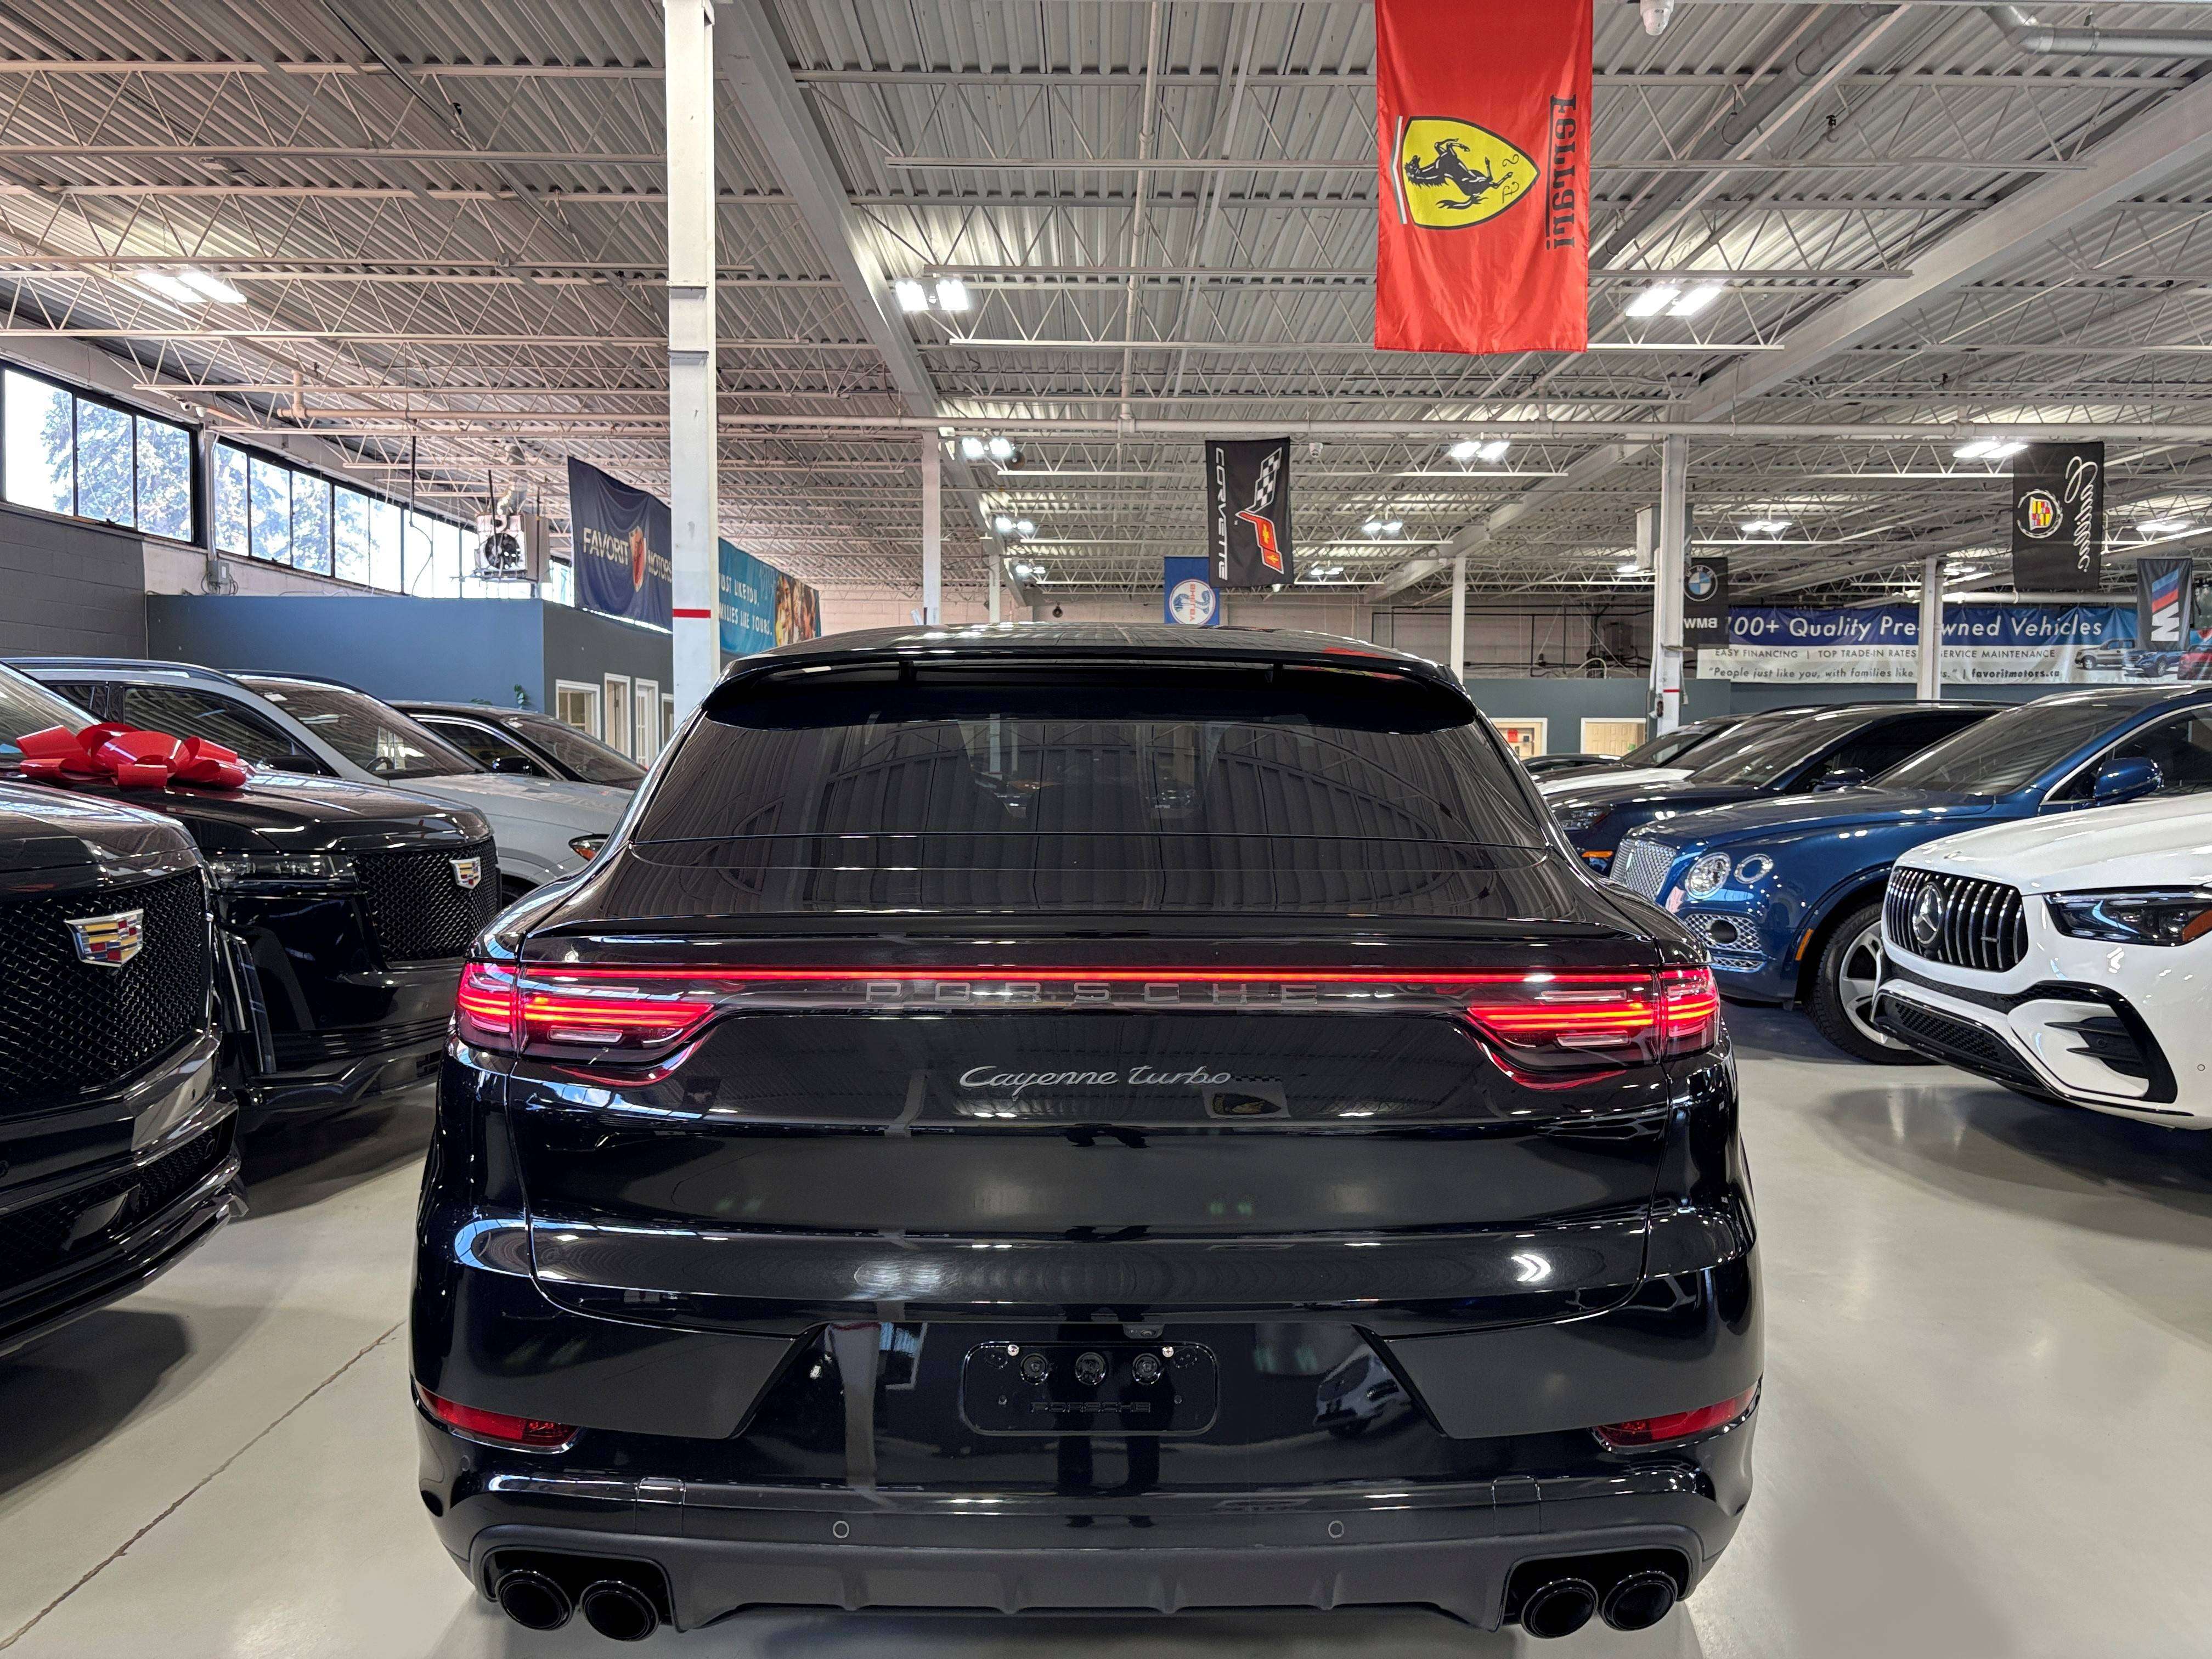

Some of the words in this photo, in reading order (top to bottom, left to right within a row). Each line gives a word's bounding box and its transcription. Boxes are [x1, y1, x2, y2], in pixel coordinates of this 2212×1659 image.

[1216, 447, 1228, 580] CORVETTE
[583, 527, 629, 566] FAVORIT
[1789, 616, 1871, 641] Quality
[2012, 614, 2102, 636] Vehicles
[1743, 650, 1798, 658] FINANCING
[1818, 650, 1837, 658] TOP
[1841, 650, 1884, 658] TRADE-IN
[1888, 650, 1916, 658] RATES
[1941, 650, 1977, 658] ERVICE
[1982, 650, 2055, 658] MAINTENANCE
[1753, 668, 1773, 678] just
[1776, 668, 1796, 678] like
[1799, 670, 1820, 680] you,
[1825, 668, 1847, 678] with
[1850, 667, 1892, 678] families
[1895, 667, 1914, 678] like
[1972, 668, 2060, 678] favoritmotors.ca
[866, 982, 1318, 1005] PORSCHE
[959, 1065, 1118, 1099] Cayenne
